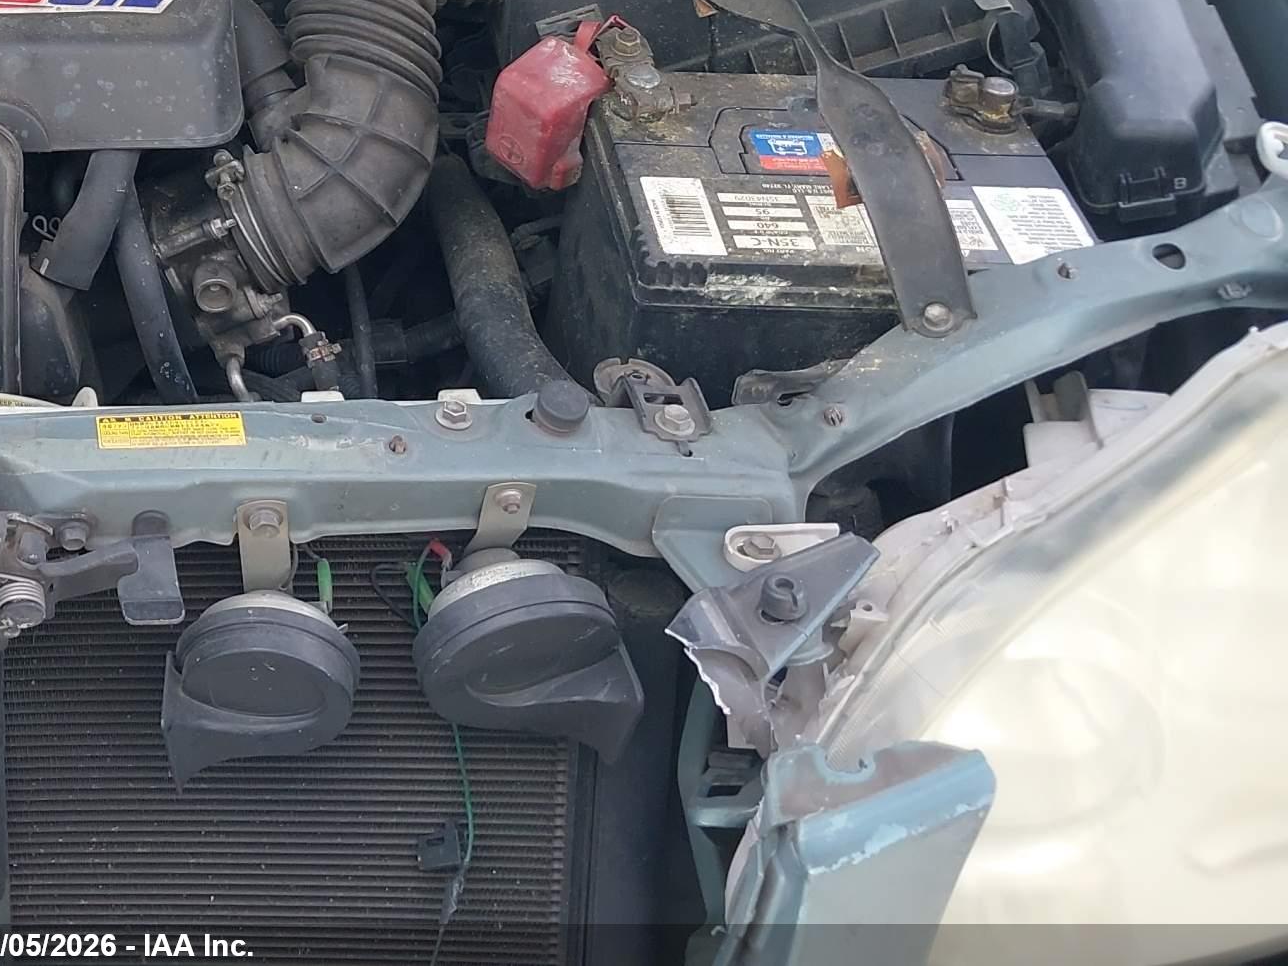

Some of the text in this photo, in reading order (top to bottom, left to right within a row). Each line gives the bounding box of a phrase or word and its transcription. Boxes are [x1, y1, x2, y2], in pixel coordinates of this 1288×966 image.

[749, 237, 800, 248] 35N-C
[138, 412, 237, 422] CAUTION ATTENTION
